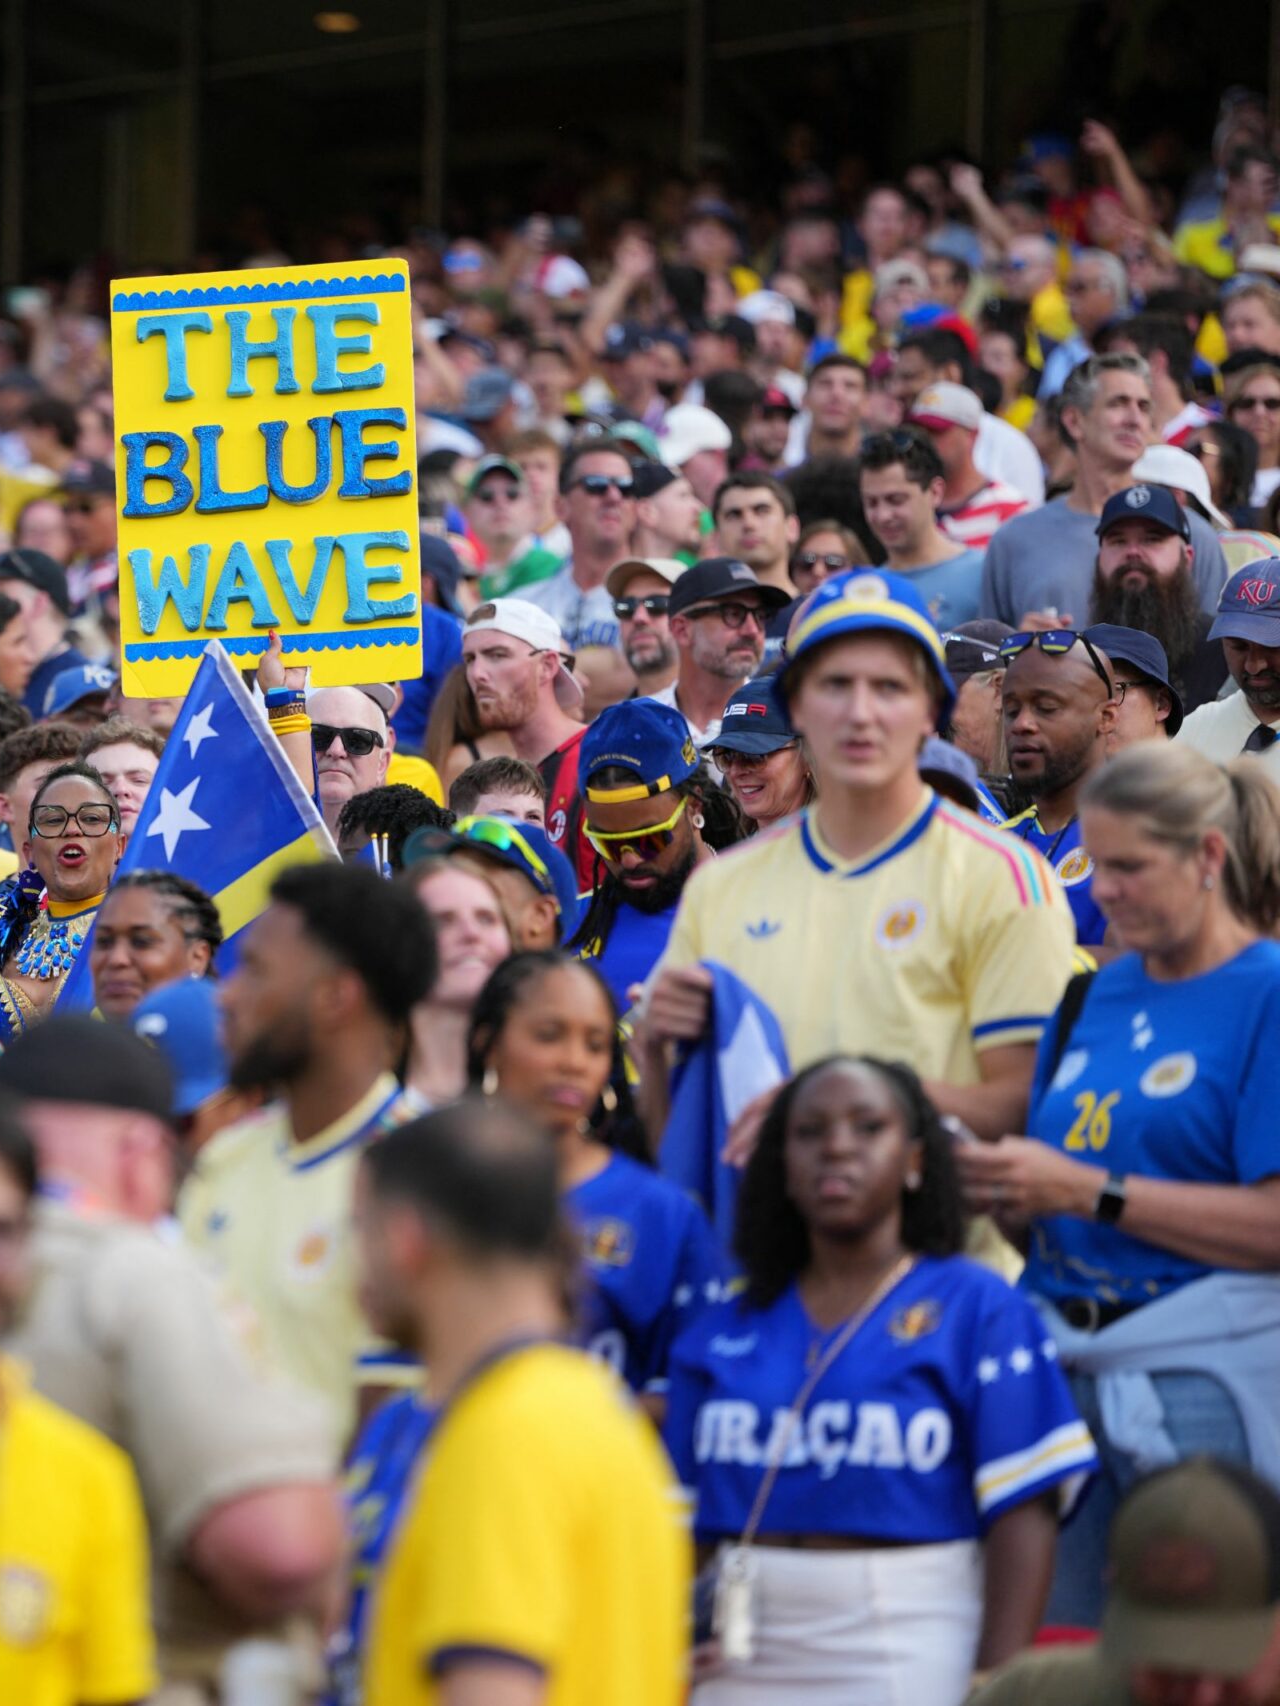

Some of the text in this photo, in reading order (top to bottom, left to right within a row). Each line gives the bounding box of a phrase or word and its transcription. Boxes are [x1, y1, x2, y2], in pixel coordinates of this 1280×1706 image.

[136, 301, 386, 402] THE
[120, 406, 413, 519] BLUE
[127, 530, 417, 635] WAVE
[1236, 579, 1277, 606] KU
[722, 703, 768, 718] USA
[1064, 1089, 1121, 1152] 26
